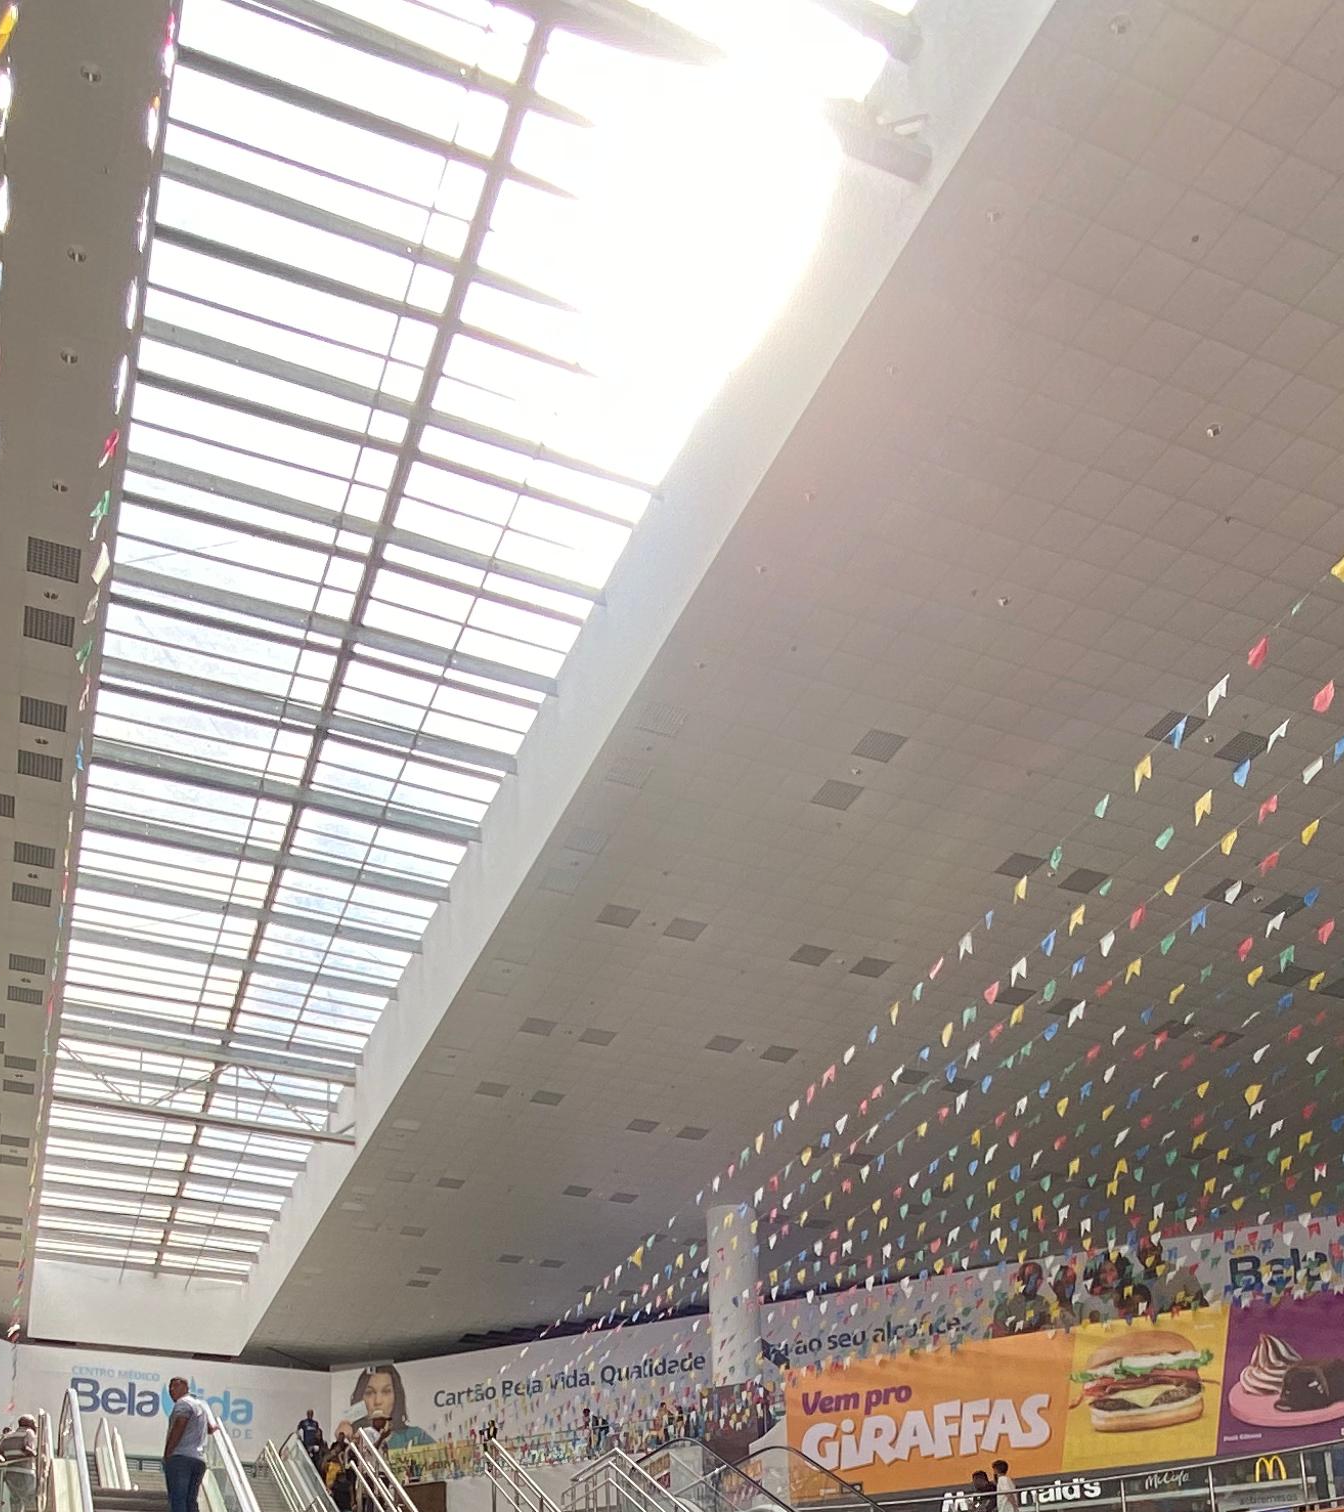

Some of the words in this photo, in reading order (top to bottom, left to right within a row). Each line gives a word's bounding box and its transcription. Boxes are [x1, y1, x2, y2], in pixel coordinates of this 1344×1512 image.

[827, 1330, 866, 1349] seu
[434, 1384, 497, 1408] Cartão
[601, 1353, 706, 1387] Qualidade
[802, 1391, 860, 1415] Vem
[864, 1385, 912, 1415] pro
